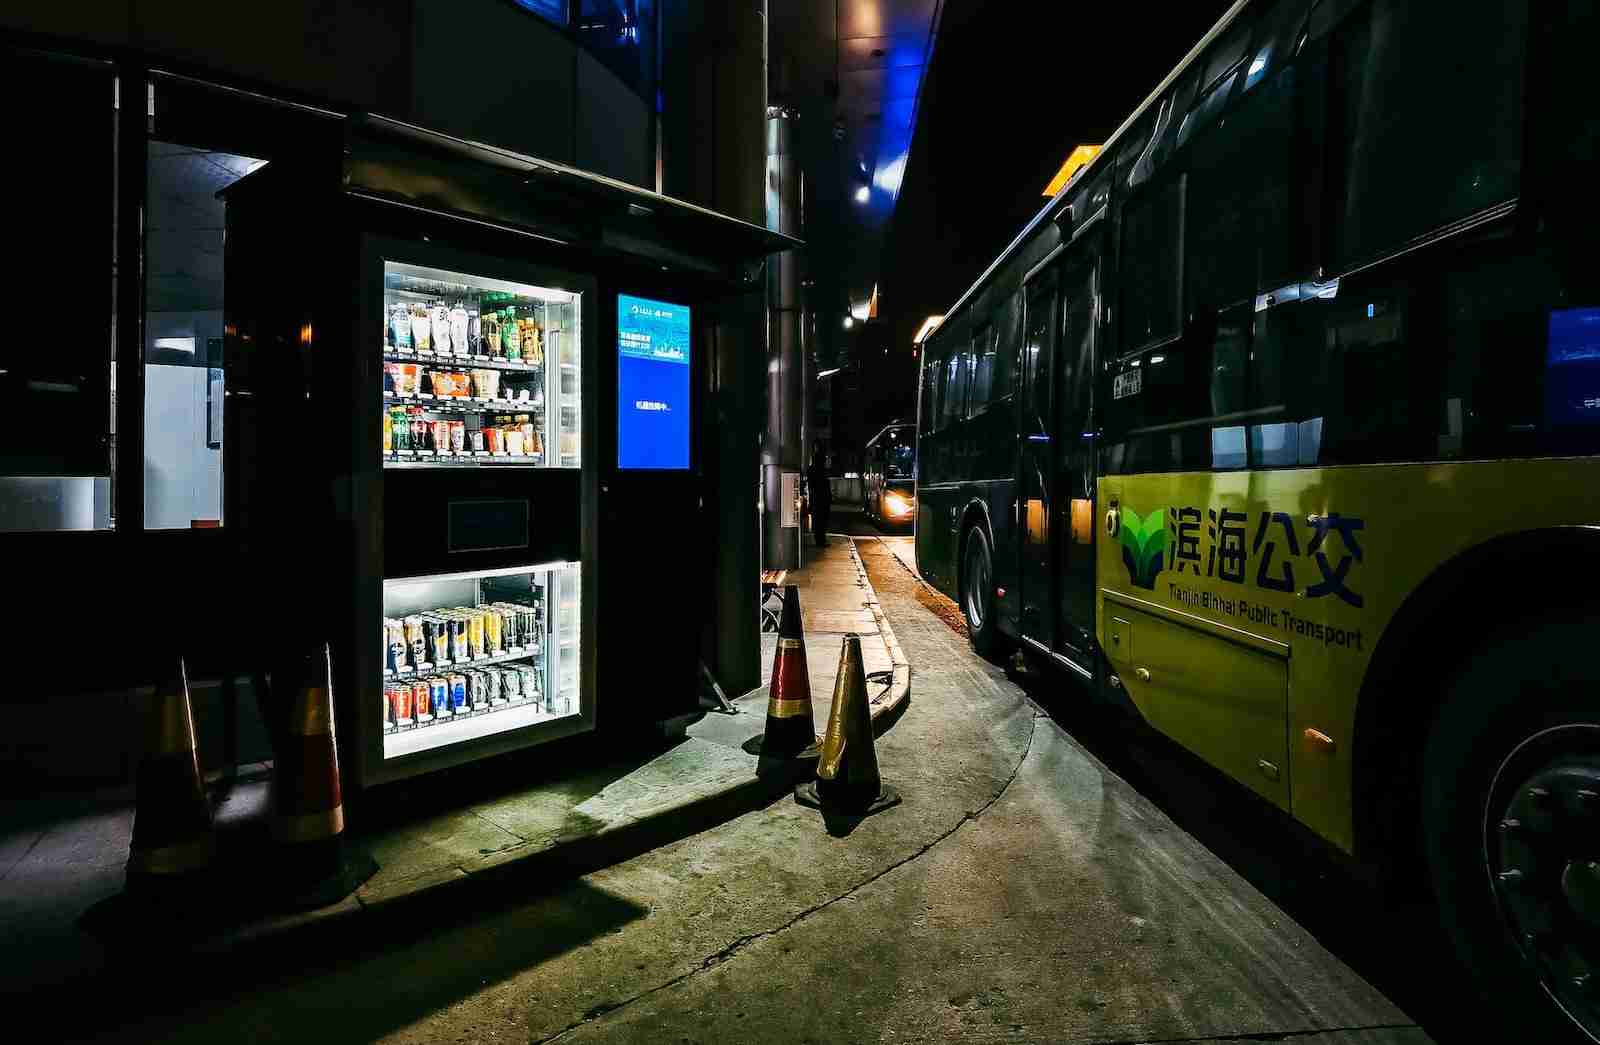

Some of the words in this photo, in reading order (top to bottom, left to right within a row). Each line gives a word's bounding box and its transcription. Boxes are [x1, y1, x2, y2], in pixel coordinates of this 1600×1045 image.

[1169, 506, 1365, 608] 滨海公交
[1169, 583, 1200, 607] Tianjin
[1202, 591, 1236, 616] Binhai
[1239, 601, 1278, 627] Public
[1281, 611, 1362, 650] Transport
